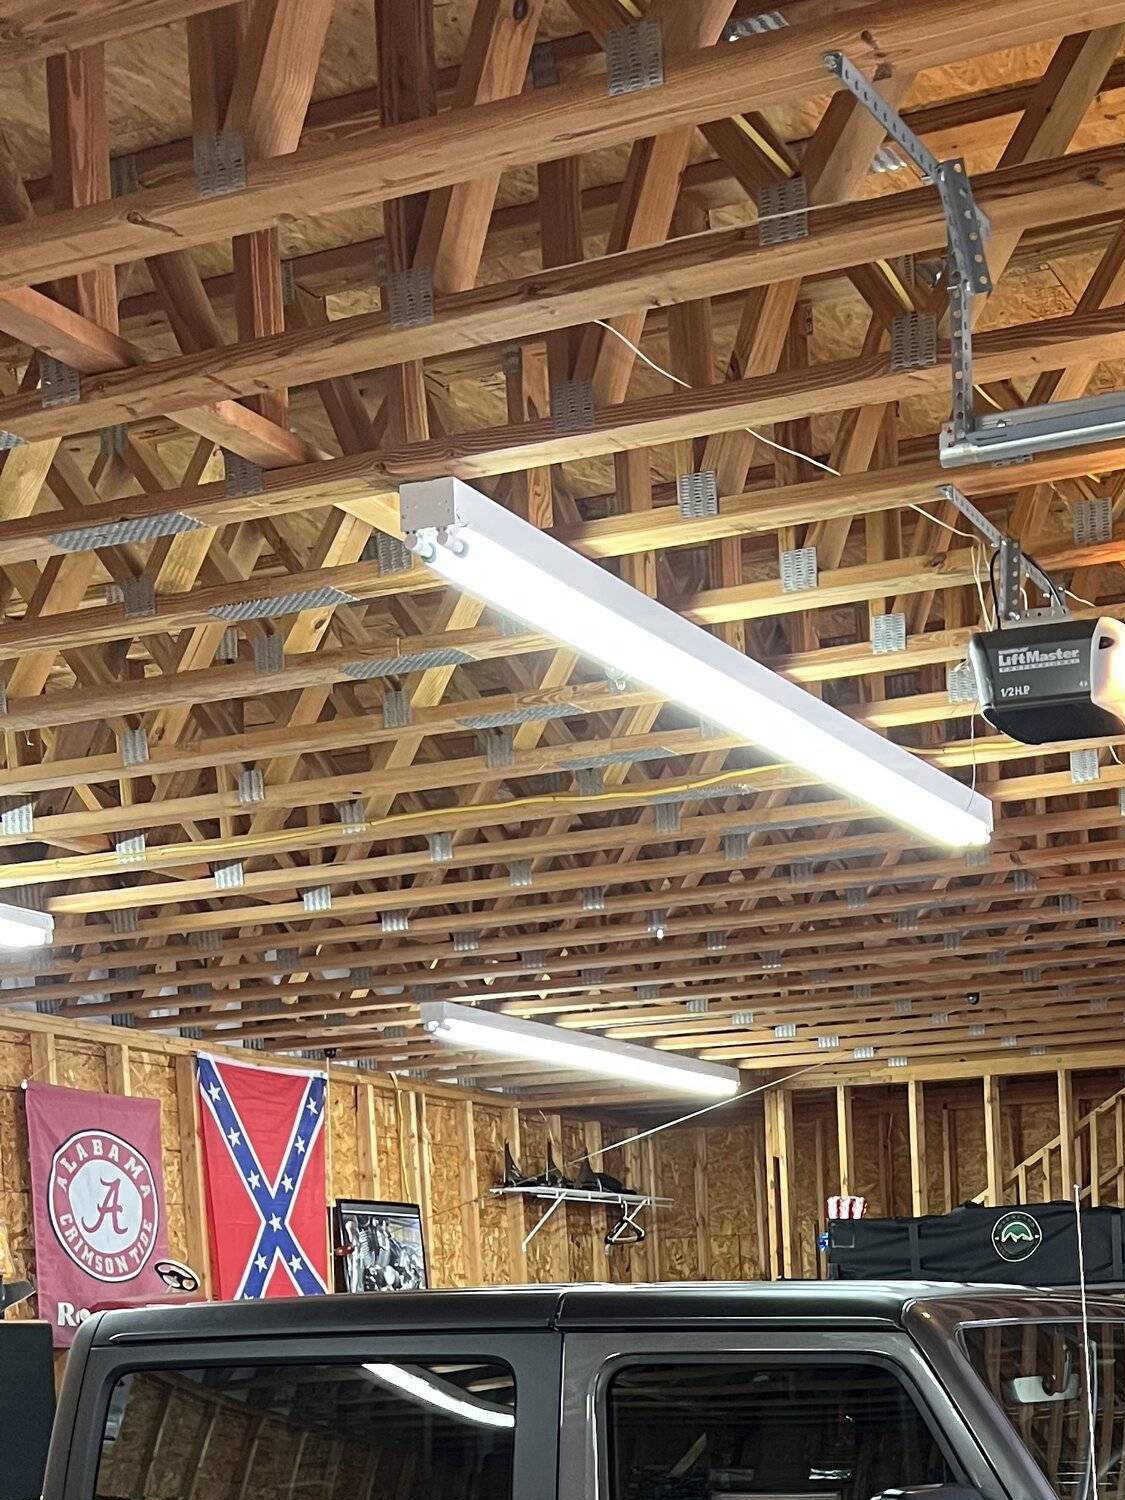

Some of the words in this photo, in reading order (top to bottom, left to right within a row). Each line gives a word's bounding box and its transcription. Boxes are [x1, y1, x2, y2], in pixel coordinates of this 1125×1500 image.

[998, 648, 1079, 667] LiftMaster
[57, 1139, 151, 1198] ALABAMA
[81, 1177, 128, 1235] A
[59, 1213, 129, 1273] CRIMSON
[129, 1221, 153, 1264] TIDE
